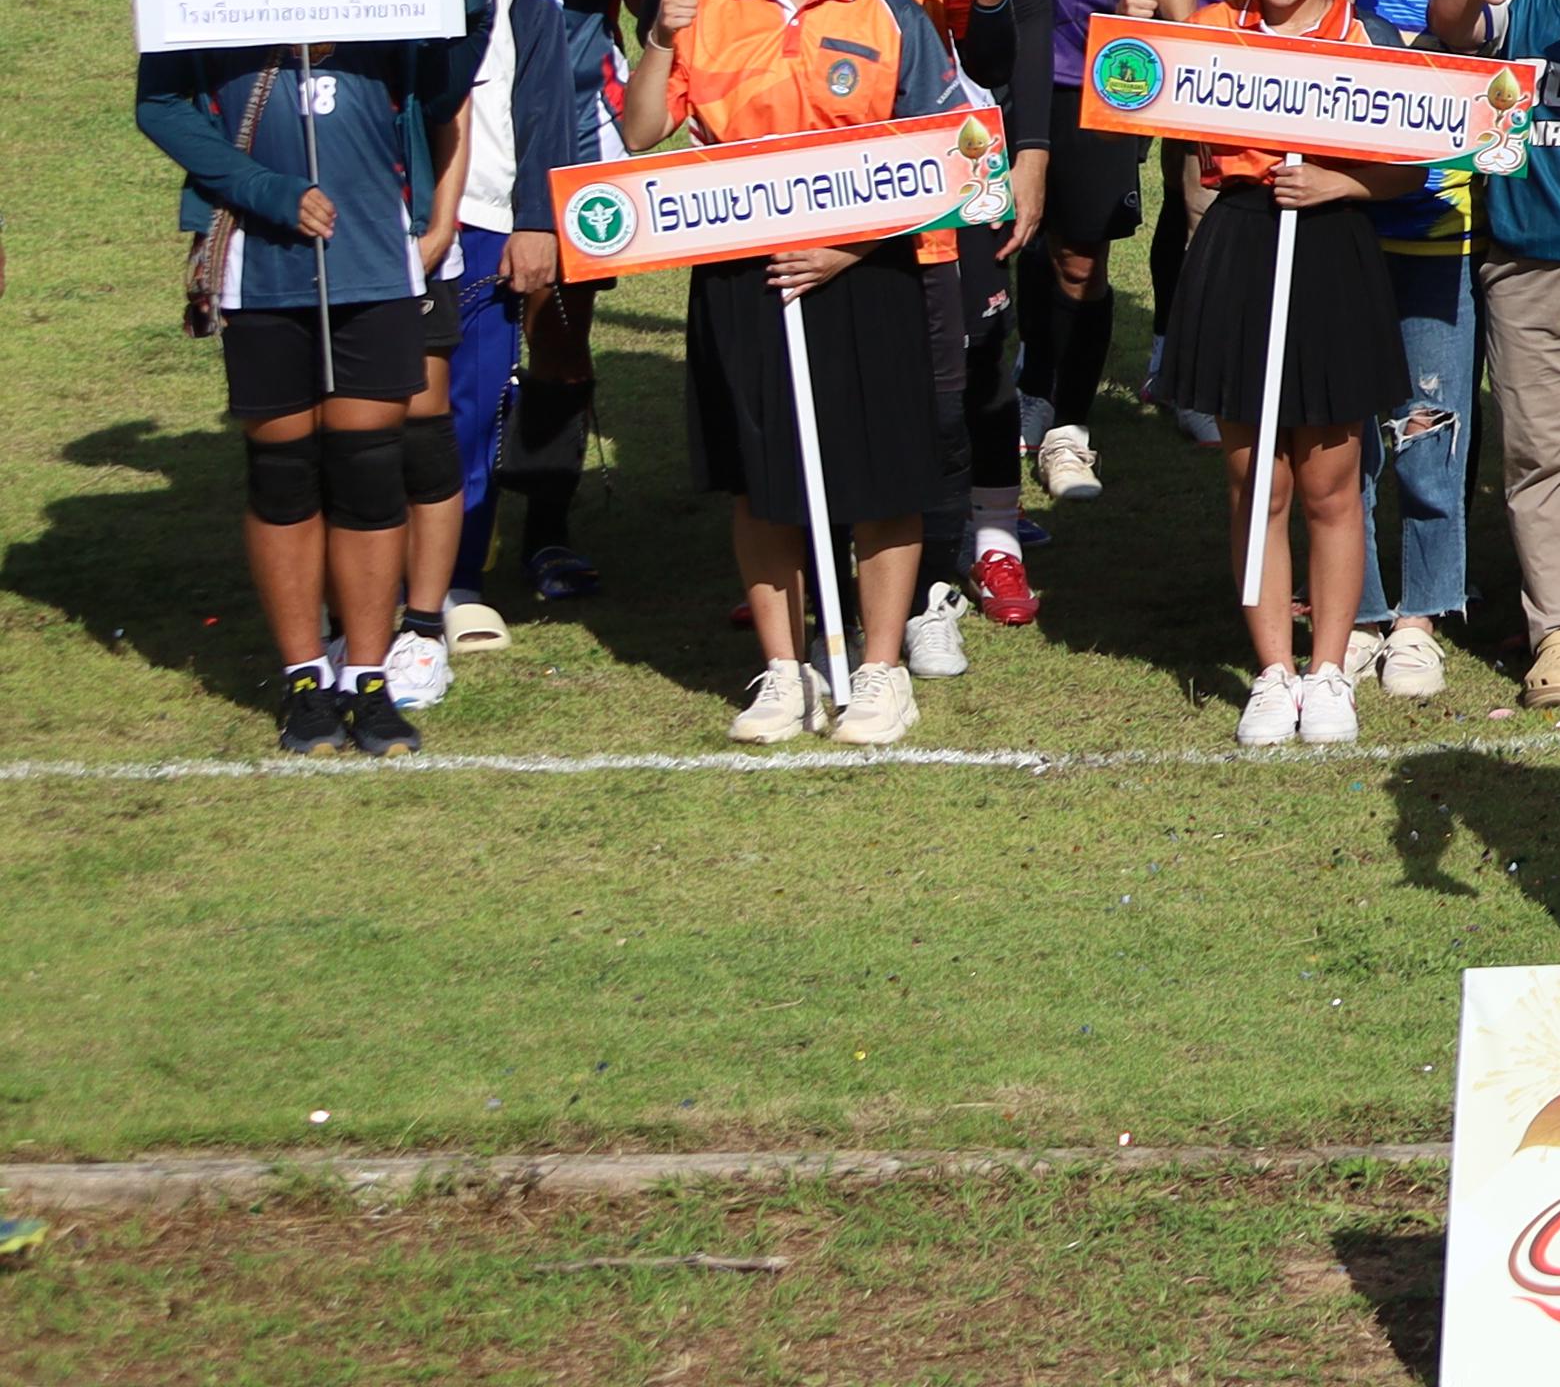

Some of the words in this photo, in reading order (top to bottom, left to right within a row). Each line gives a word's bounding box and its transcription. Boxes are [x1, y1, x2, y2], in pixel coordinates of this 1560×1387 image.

[1174, 56, 1470, 149] หน่วยเฉพาะกิจราชมนู
[645, 153, 946, 235] โรงพยาบาลแม่สอด
